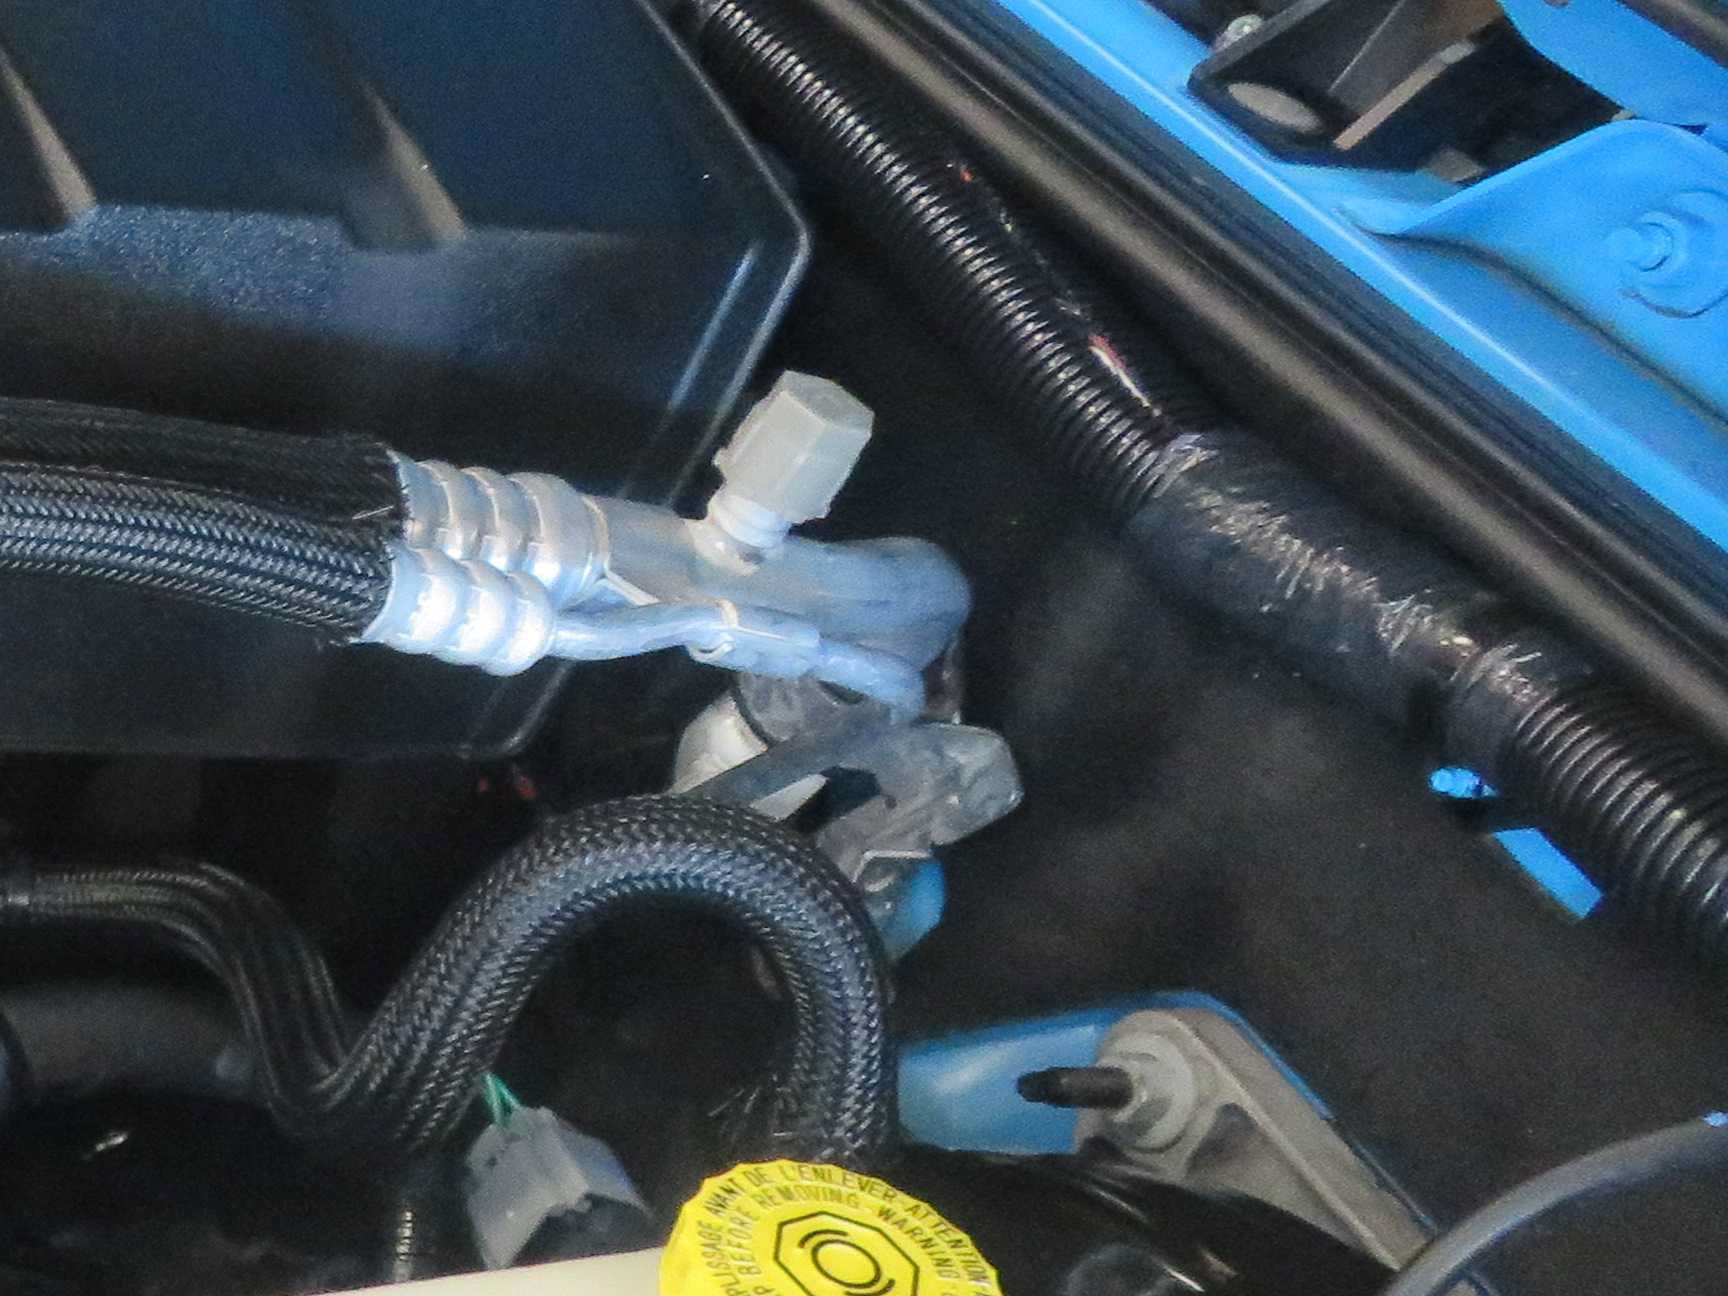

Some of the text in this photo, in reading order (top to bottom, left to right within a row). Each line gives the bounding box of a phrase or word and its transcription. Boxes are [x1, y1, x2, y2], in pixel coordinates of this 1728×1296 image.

[726, 1205, 763, 1277] BEFORE
[875, 1205, 963, 1283] WARNING
[906, 1203, 993, 1288] ATTENTION
